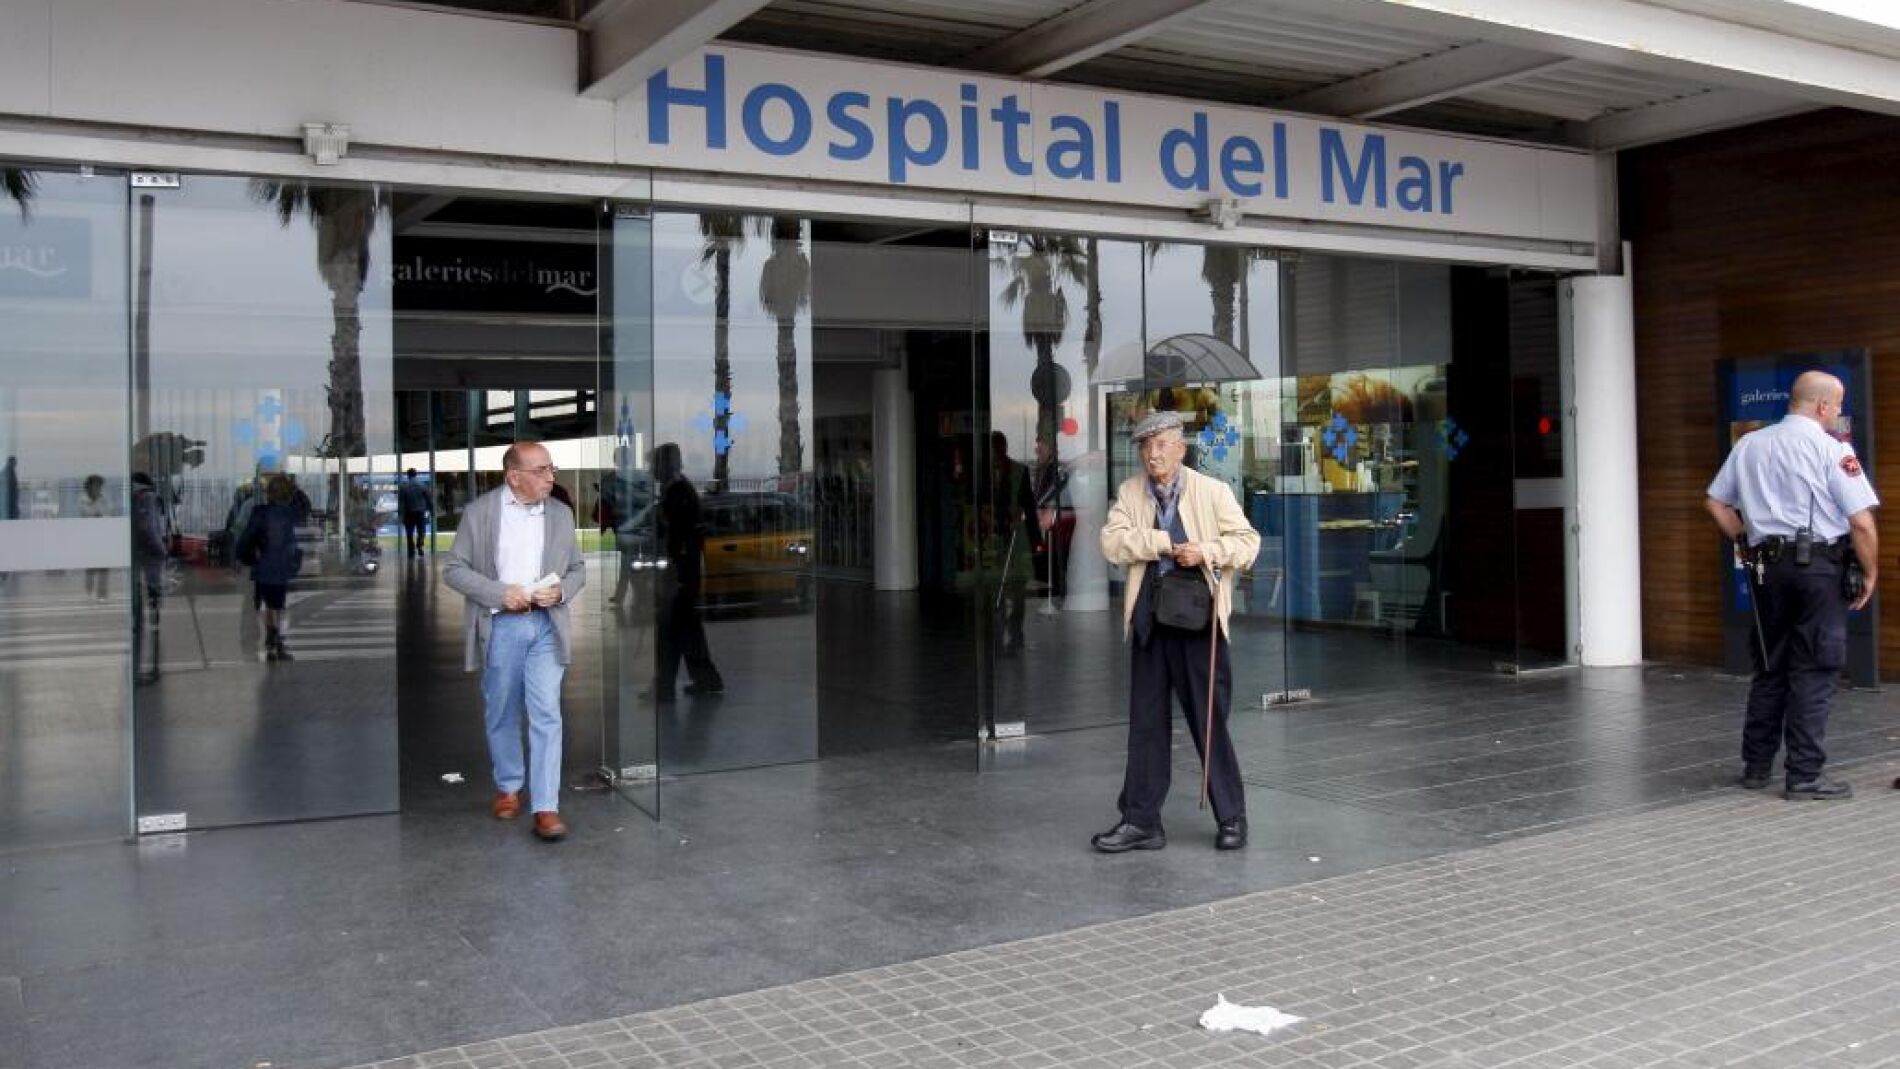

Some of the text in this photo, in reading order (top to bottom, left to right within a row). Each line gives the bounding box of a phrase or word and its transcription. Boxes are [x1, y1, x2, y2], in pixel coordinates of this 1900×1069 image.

[647, 54, 1464, 214] Hospital del Mar
